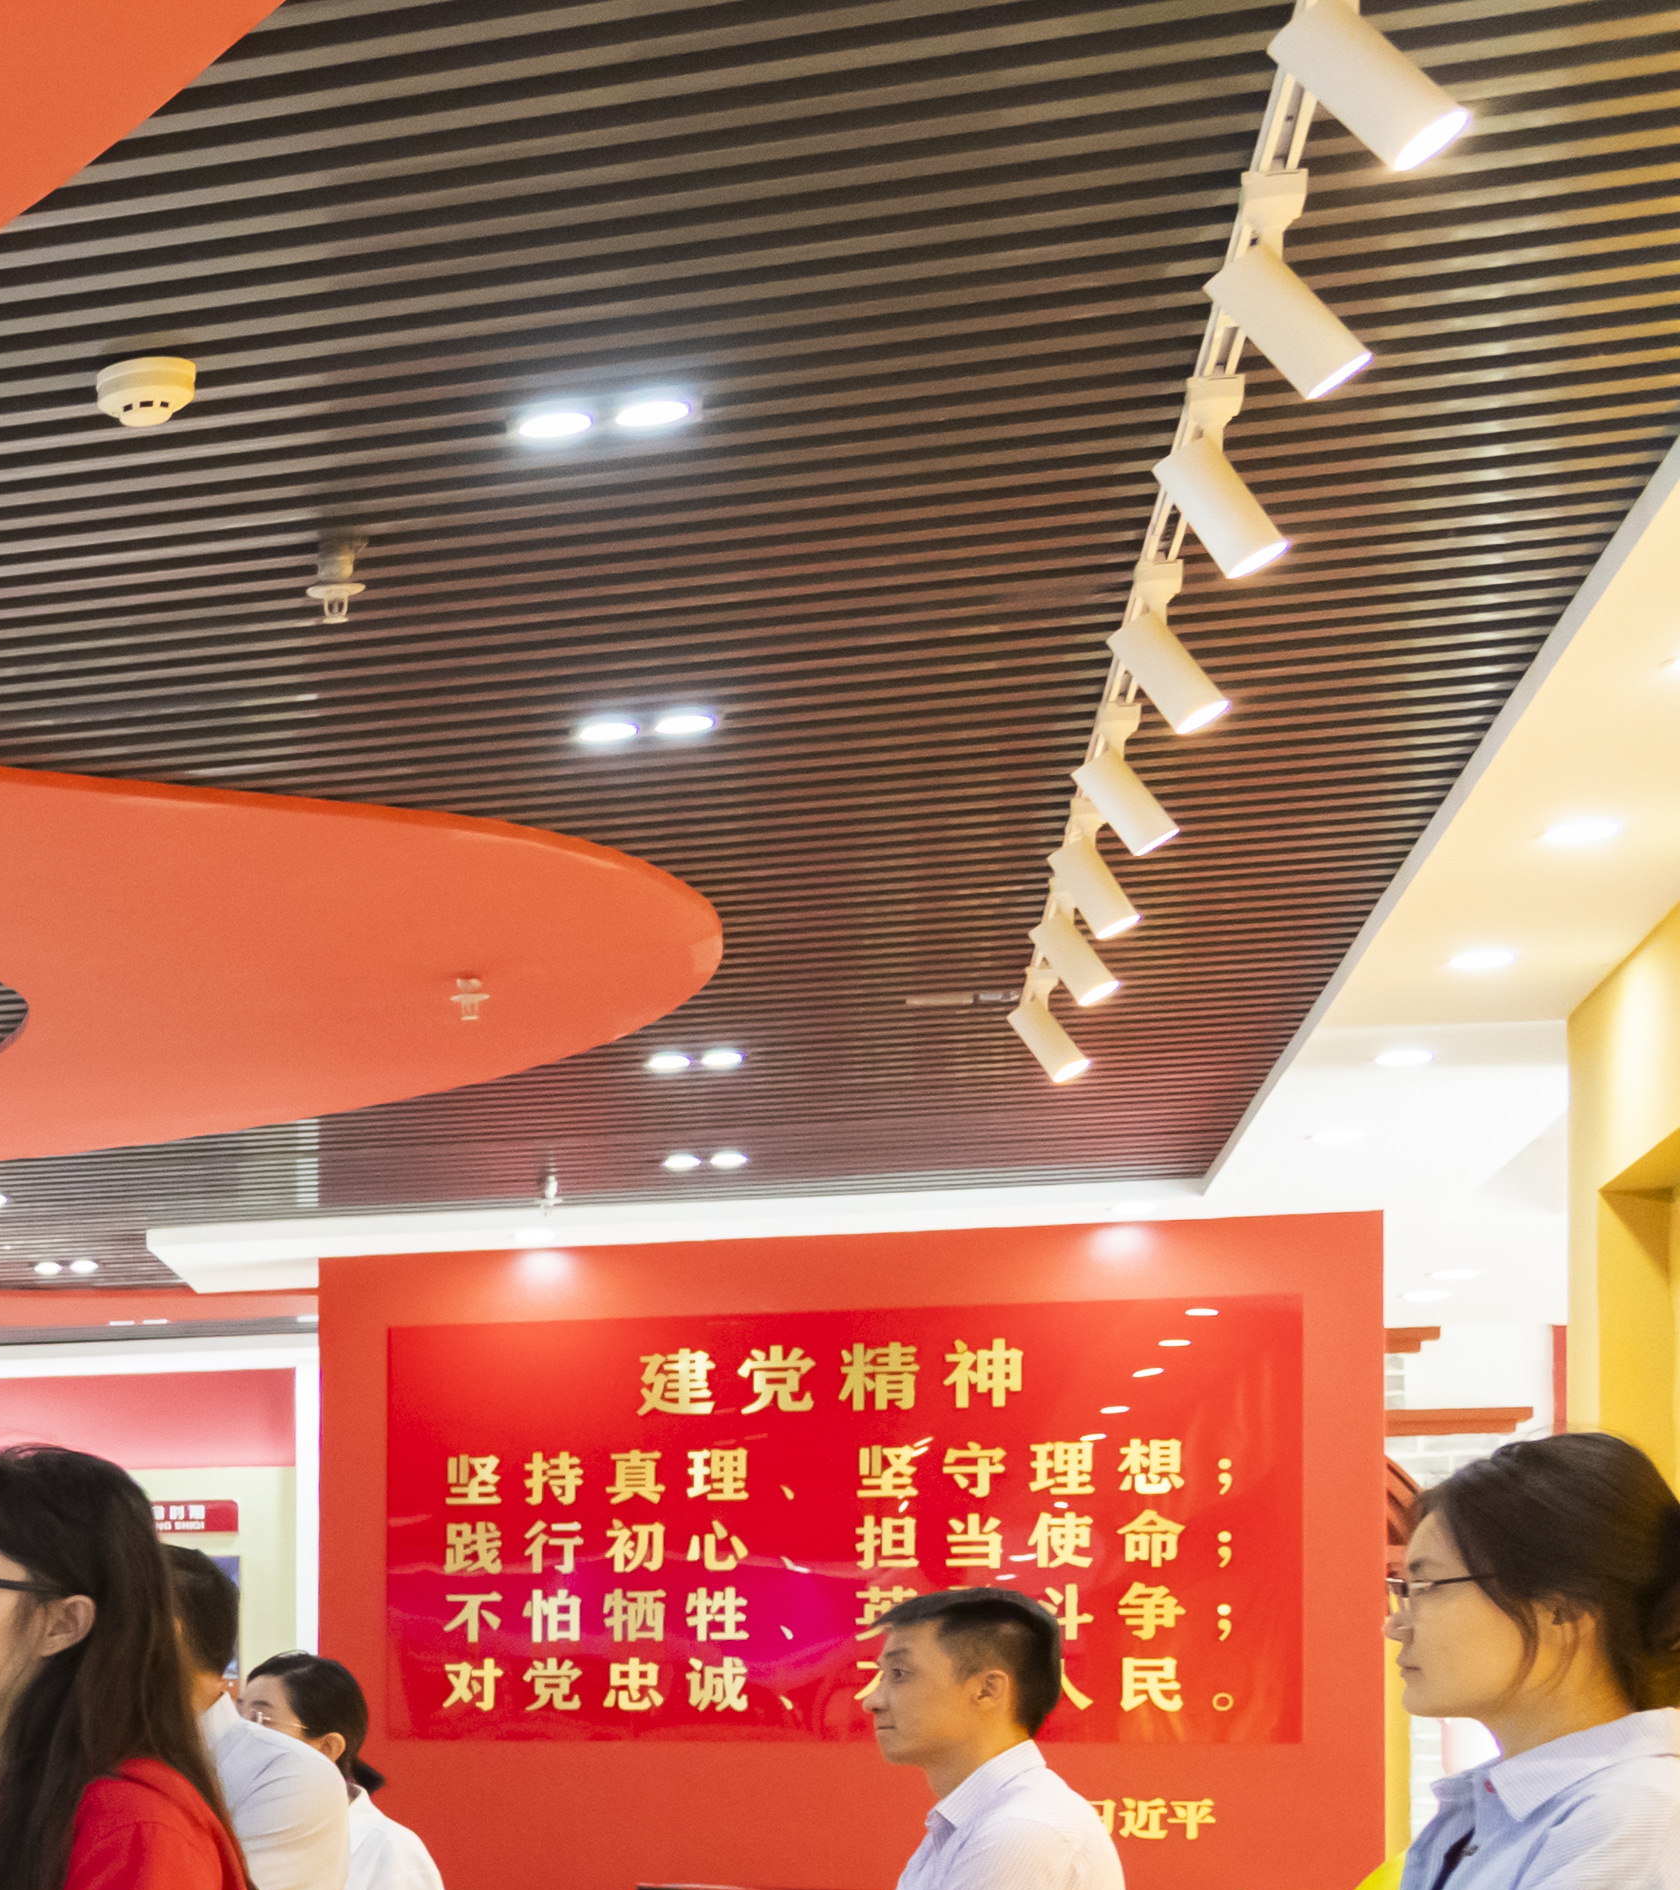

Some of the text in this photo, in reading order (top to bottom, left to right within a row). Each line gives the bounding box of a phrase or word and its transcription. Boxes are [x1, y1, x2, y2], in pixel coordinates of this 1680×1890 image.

[637, 1338, 1025, 1417] 建党精神
[445, 1438, 1233, 1505] 坚持真理、坚守理想；
[445, 1509, 1233, 1576] 践行初心、担当使命；
[444, 1580, 1233, 1644] 不怕牺牲、英斗争；
[444, 1655, 1234, 1714] 对党忠诚、民。
